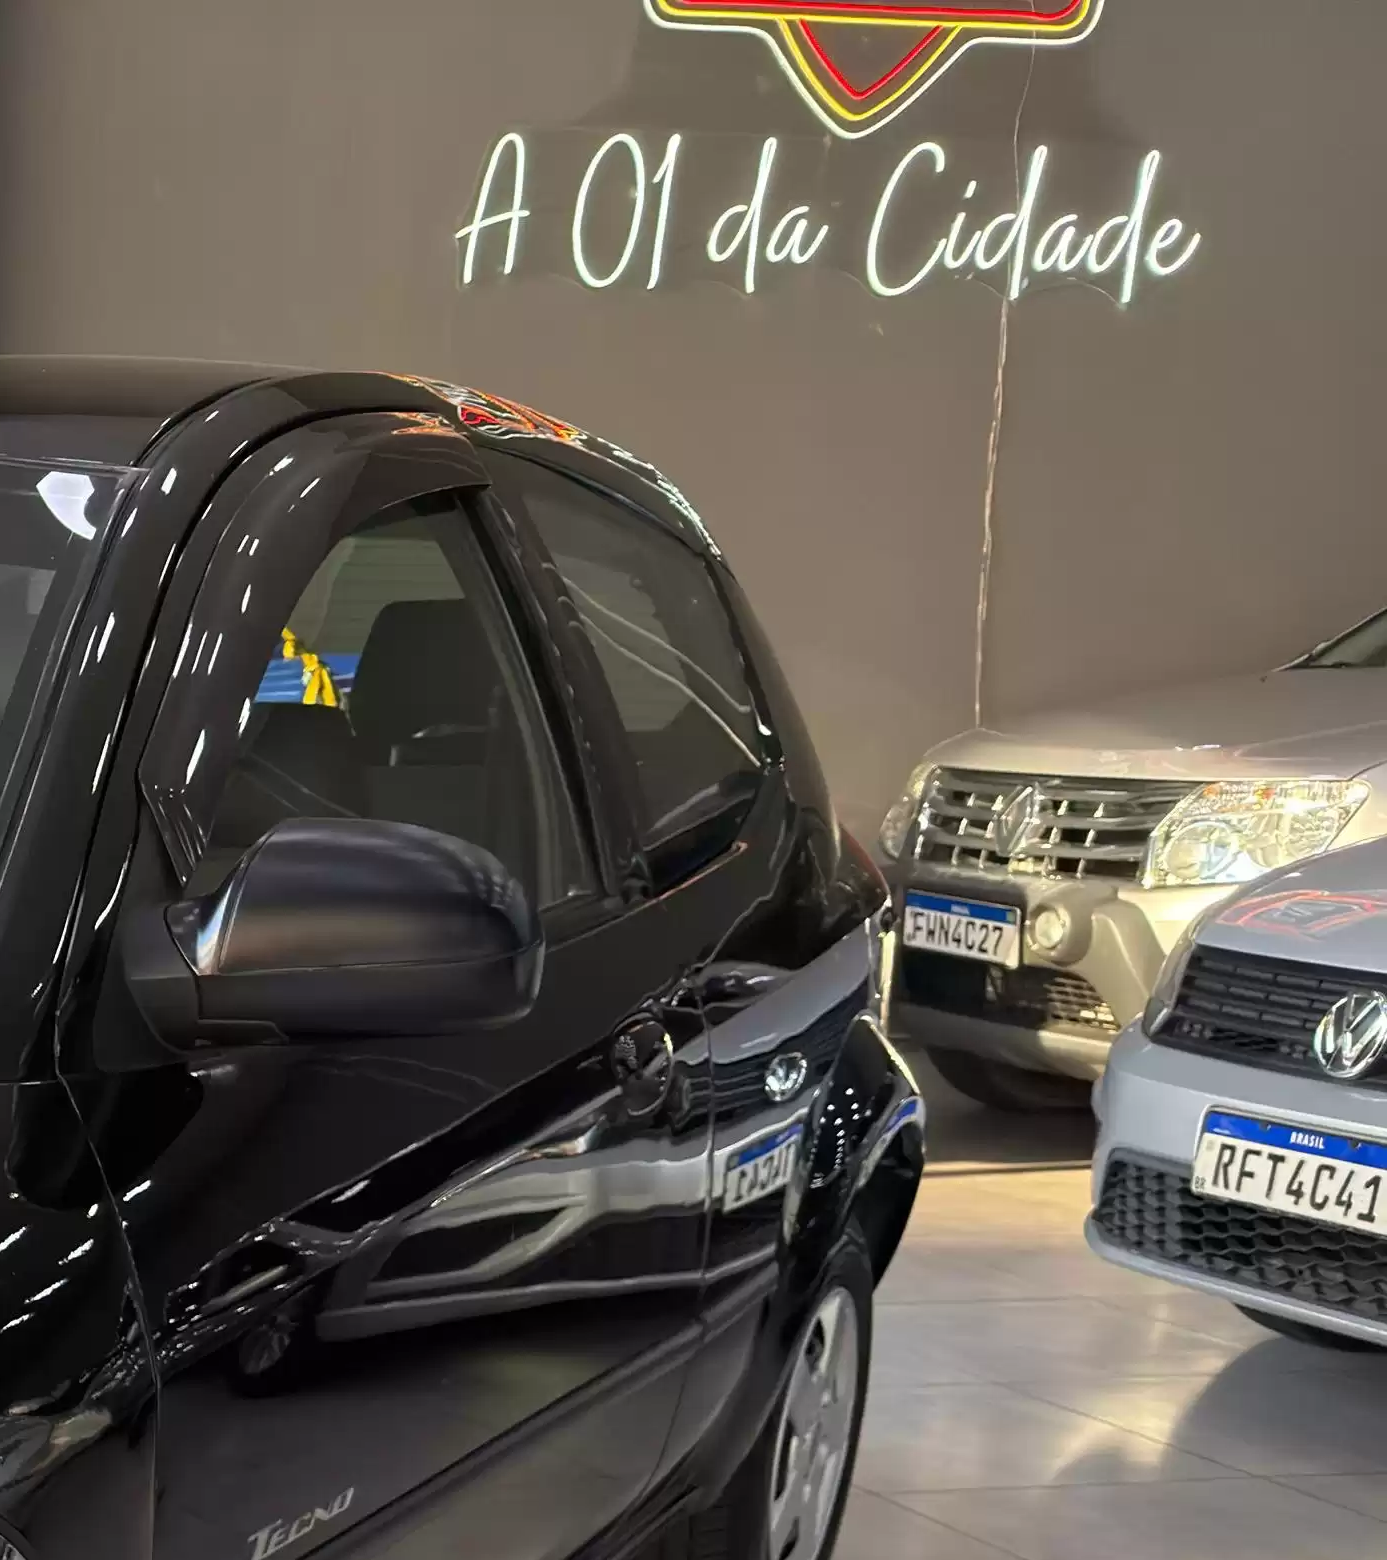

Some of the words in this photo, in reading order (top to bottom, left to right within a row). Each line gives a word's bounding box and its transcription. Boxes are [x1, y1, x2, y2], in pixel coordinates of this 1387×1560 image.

[455, 132, 530, 286] A
[706, 137, 829, 294] da
[865, 142, 1202, 305] Cidade
[1289, 1131, 1326, 1150] BRASIL
[1211, 1143, 1383, 1224] RFT4C41
